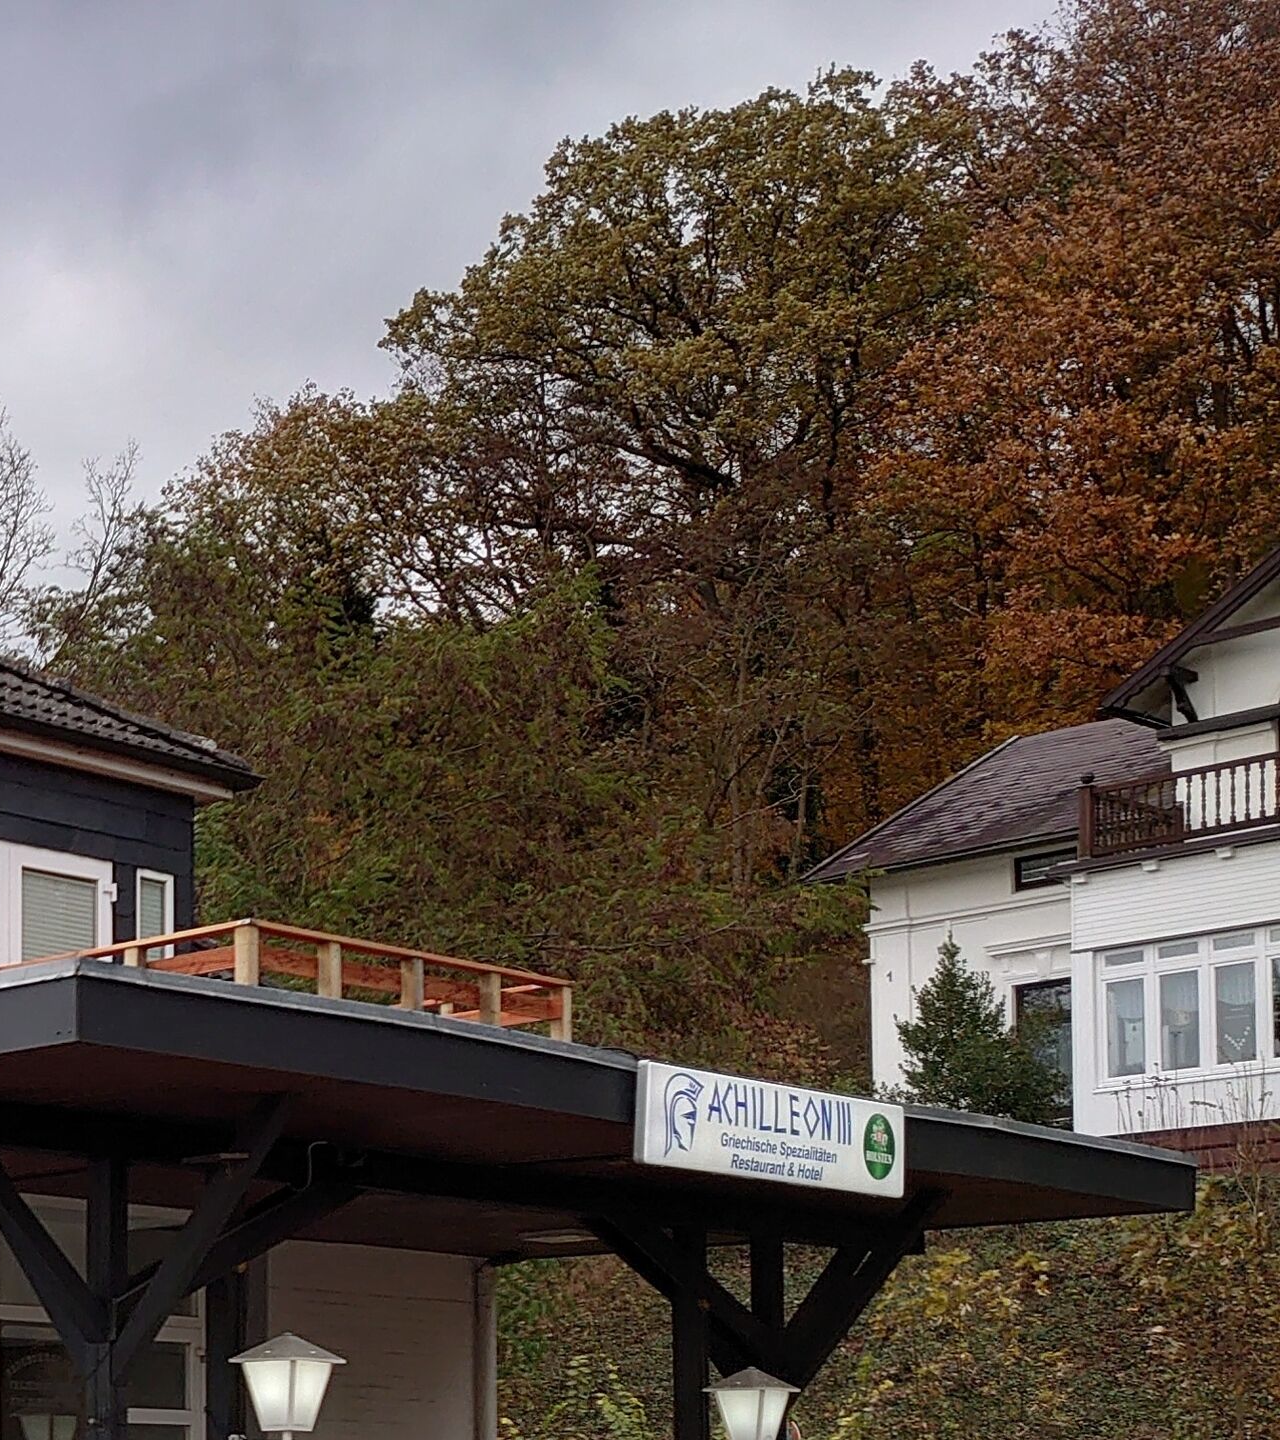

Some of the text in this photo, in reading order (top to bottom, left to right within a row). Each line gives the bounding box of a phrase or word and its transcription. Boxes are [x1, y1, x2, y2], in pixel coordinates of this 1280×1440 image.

[707, 1080, 852, 1146] ACHILLEON III
[720, 1132, 837, 1164] Griechische Spezialitäten
[730, 1153, 823, 1181] Restaurant & Hotel
